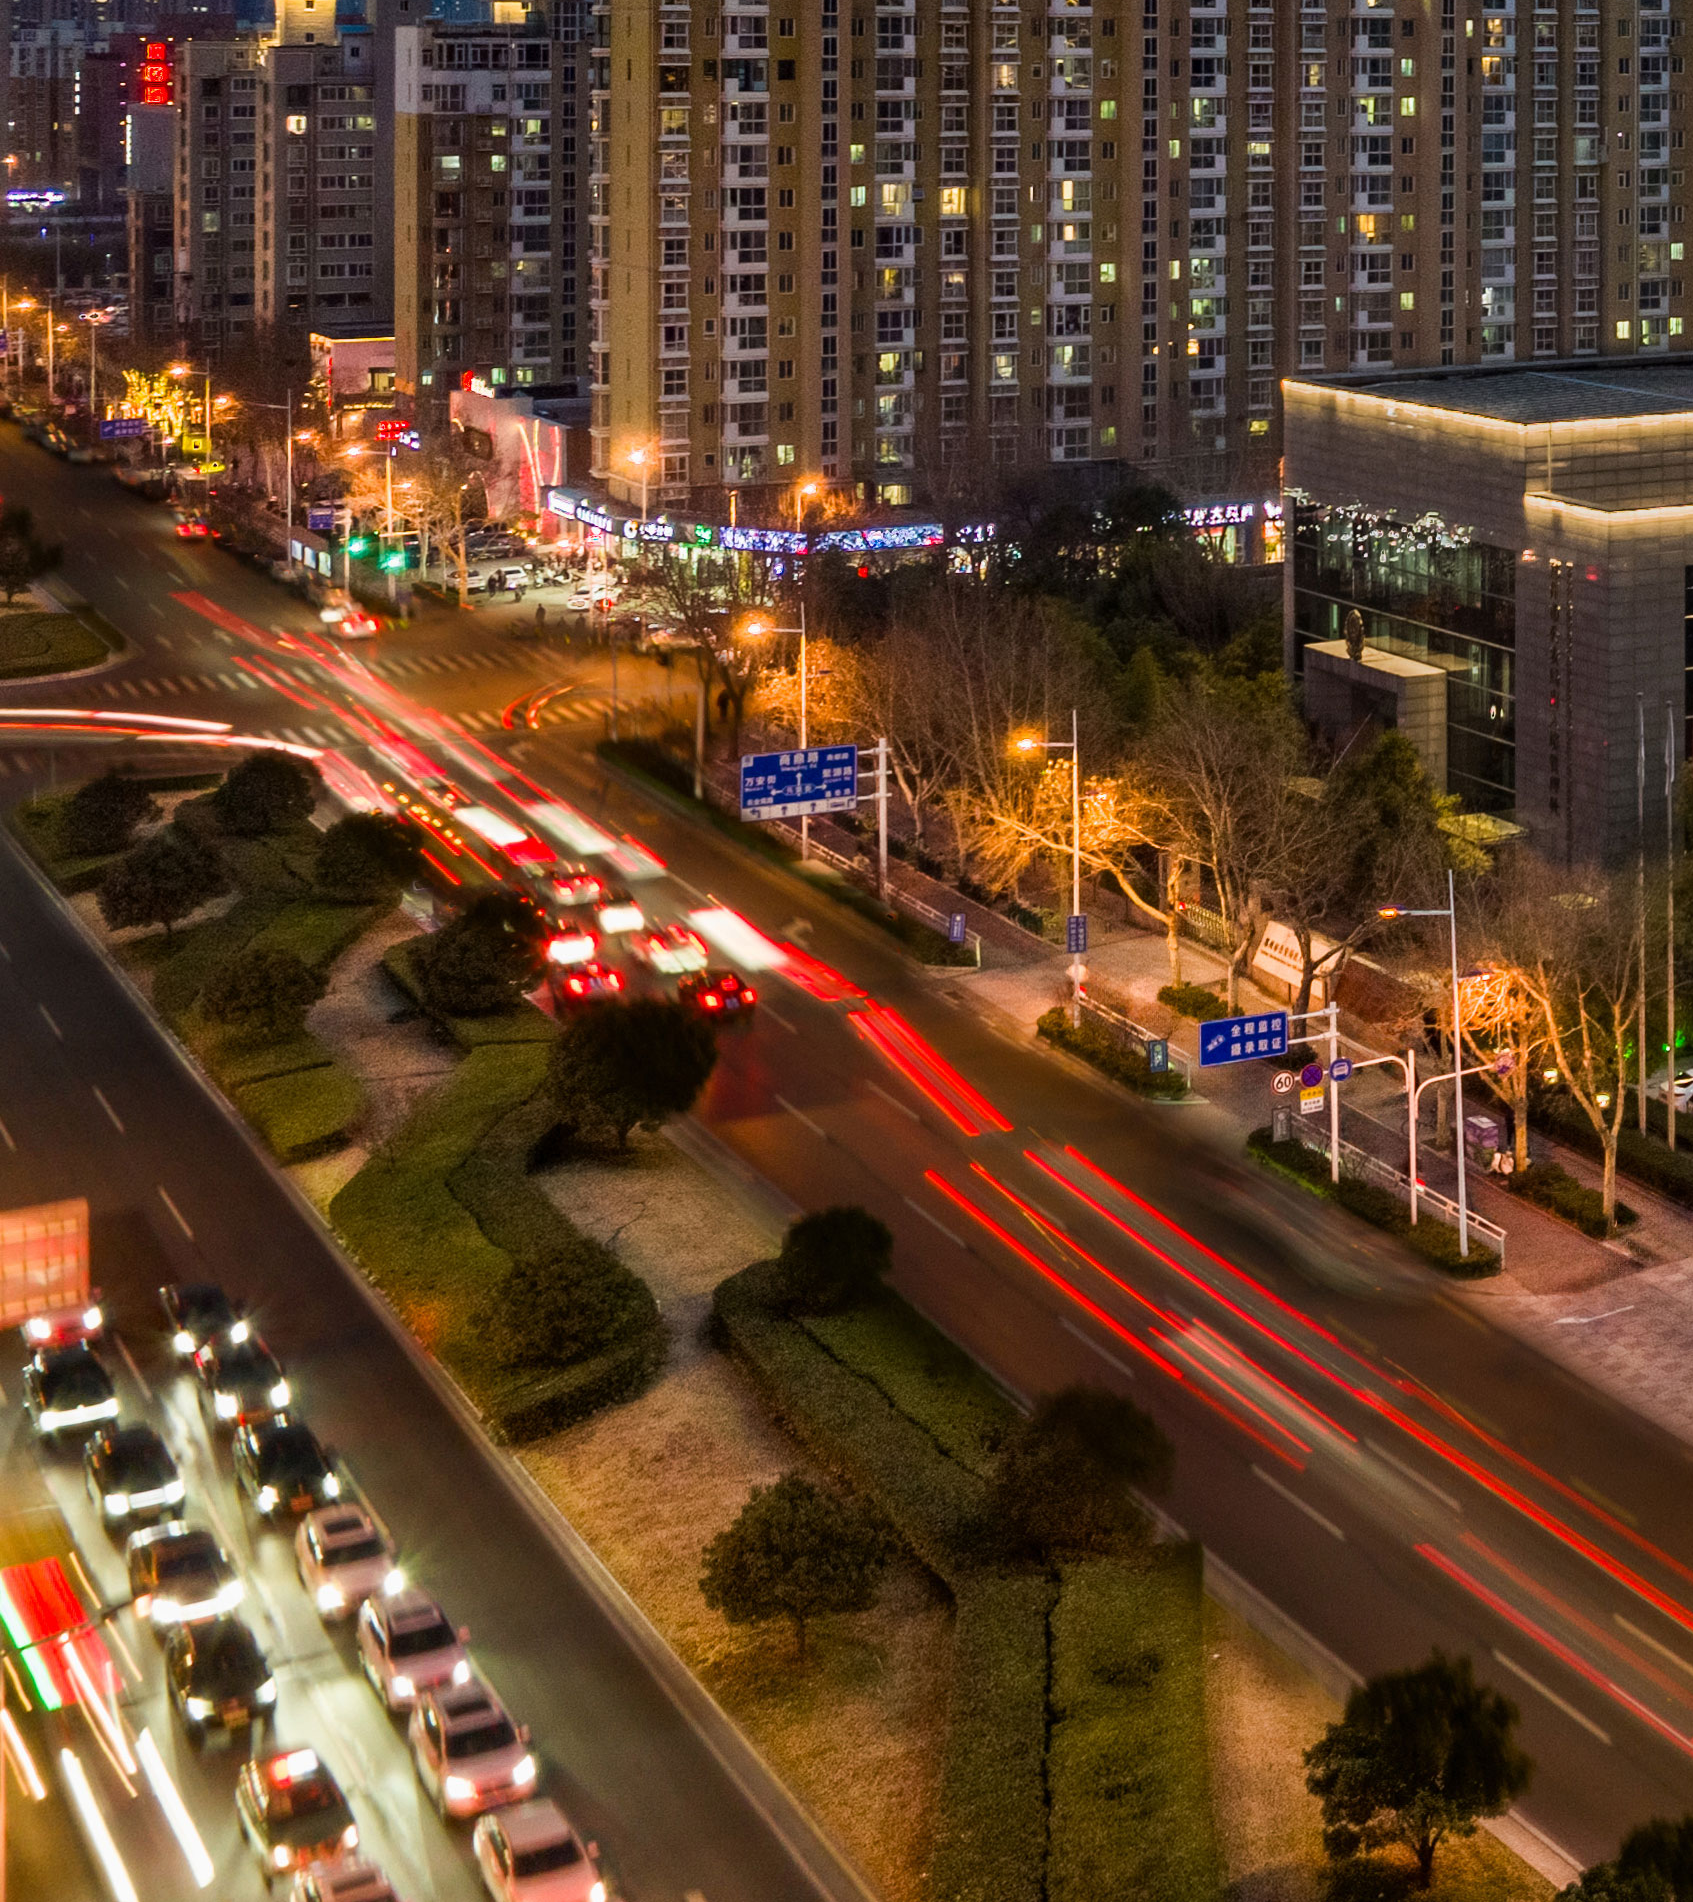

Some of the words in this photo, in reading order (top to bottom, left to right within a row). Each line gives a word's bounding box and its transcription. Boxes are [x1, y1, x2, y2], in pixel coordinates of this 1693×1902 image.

[1231, 1018, 1282, 1037] 全程监控
[1275, 1075, 1291, 1090] 60
